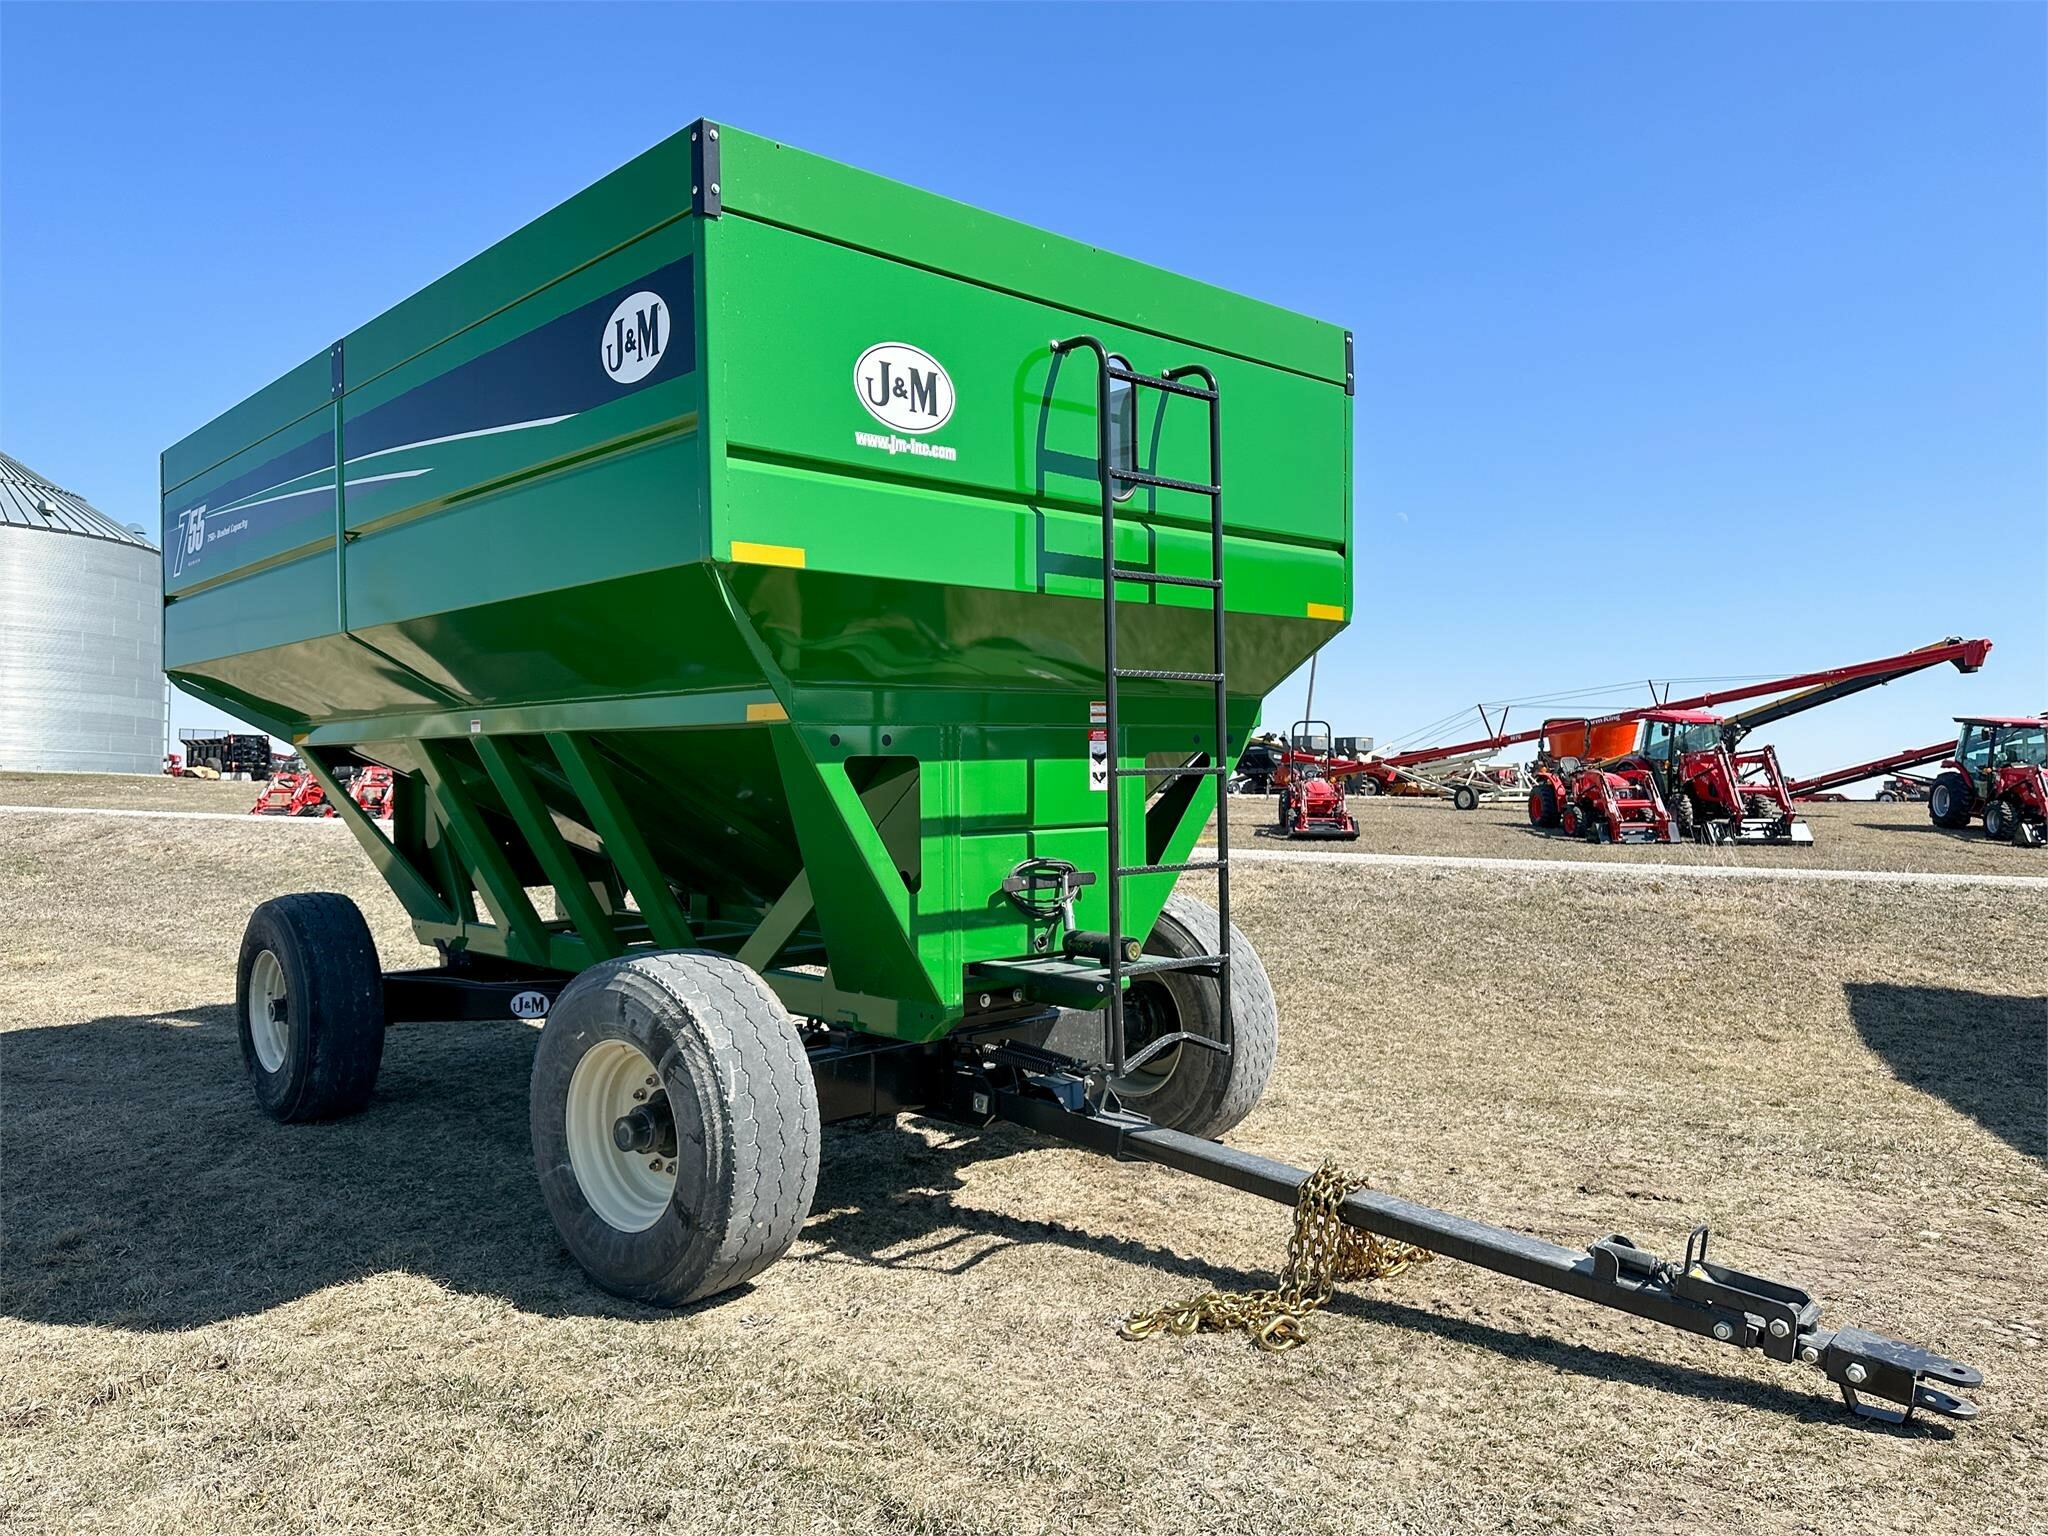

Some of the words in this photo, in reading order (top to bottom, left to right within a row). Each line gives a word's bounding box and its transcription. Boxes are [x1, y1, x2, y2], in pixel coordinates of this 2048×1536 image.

[606, 302, 660, 373] J&M
[865, 359, 939, 418] J&M
[855, 431, 957, 461] www.jm-inc.com
[173, 504, 207, 578] 755
[1603, 714, 1621, 722] King
[512, 996, 545, 1014] J&M
